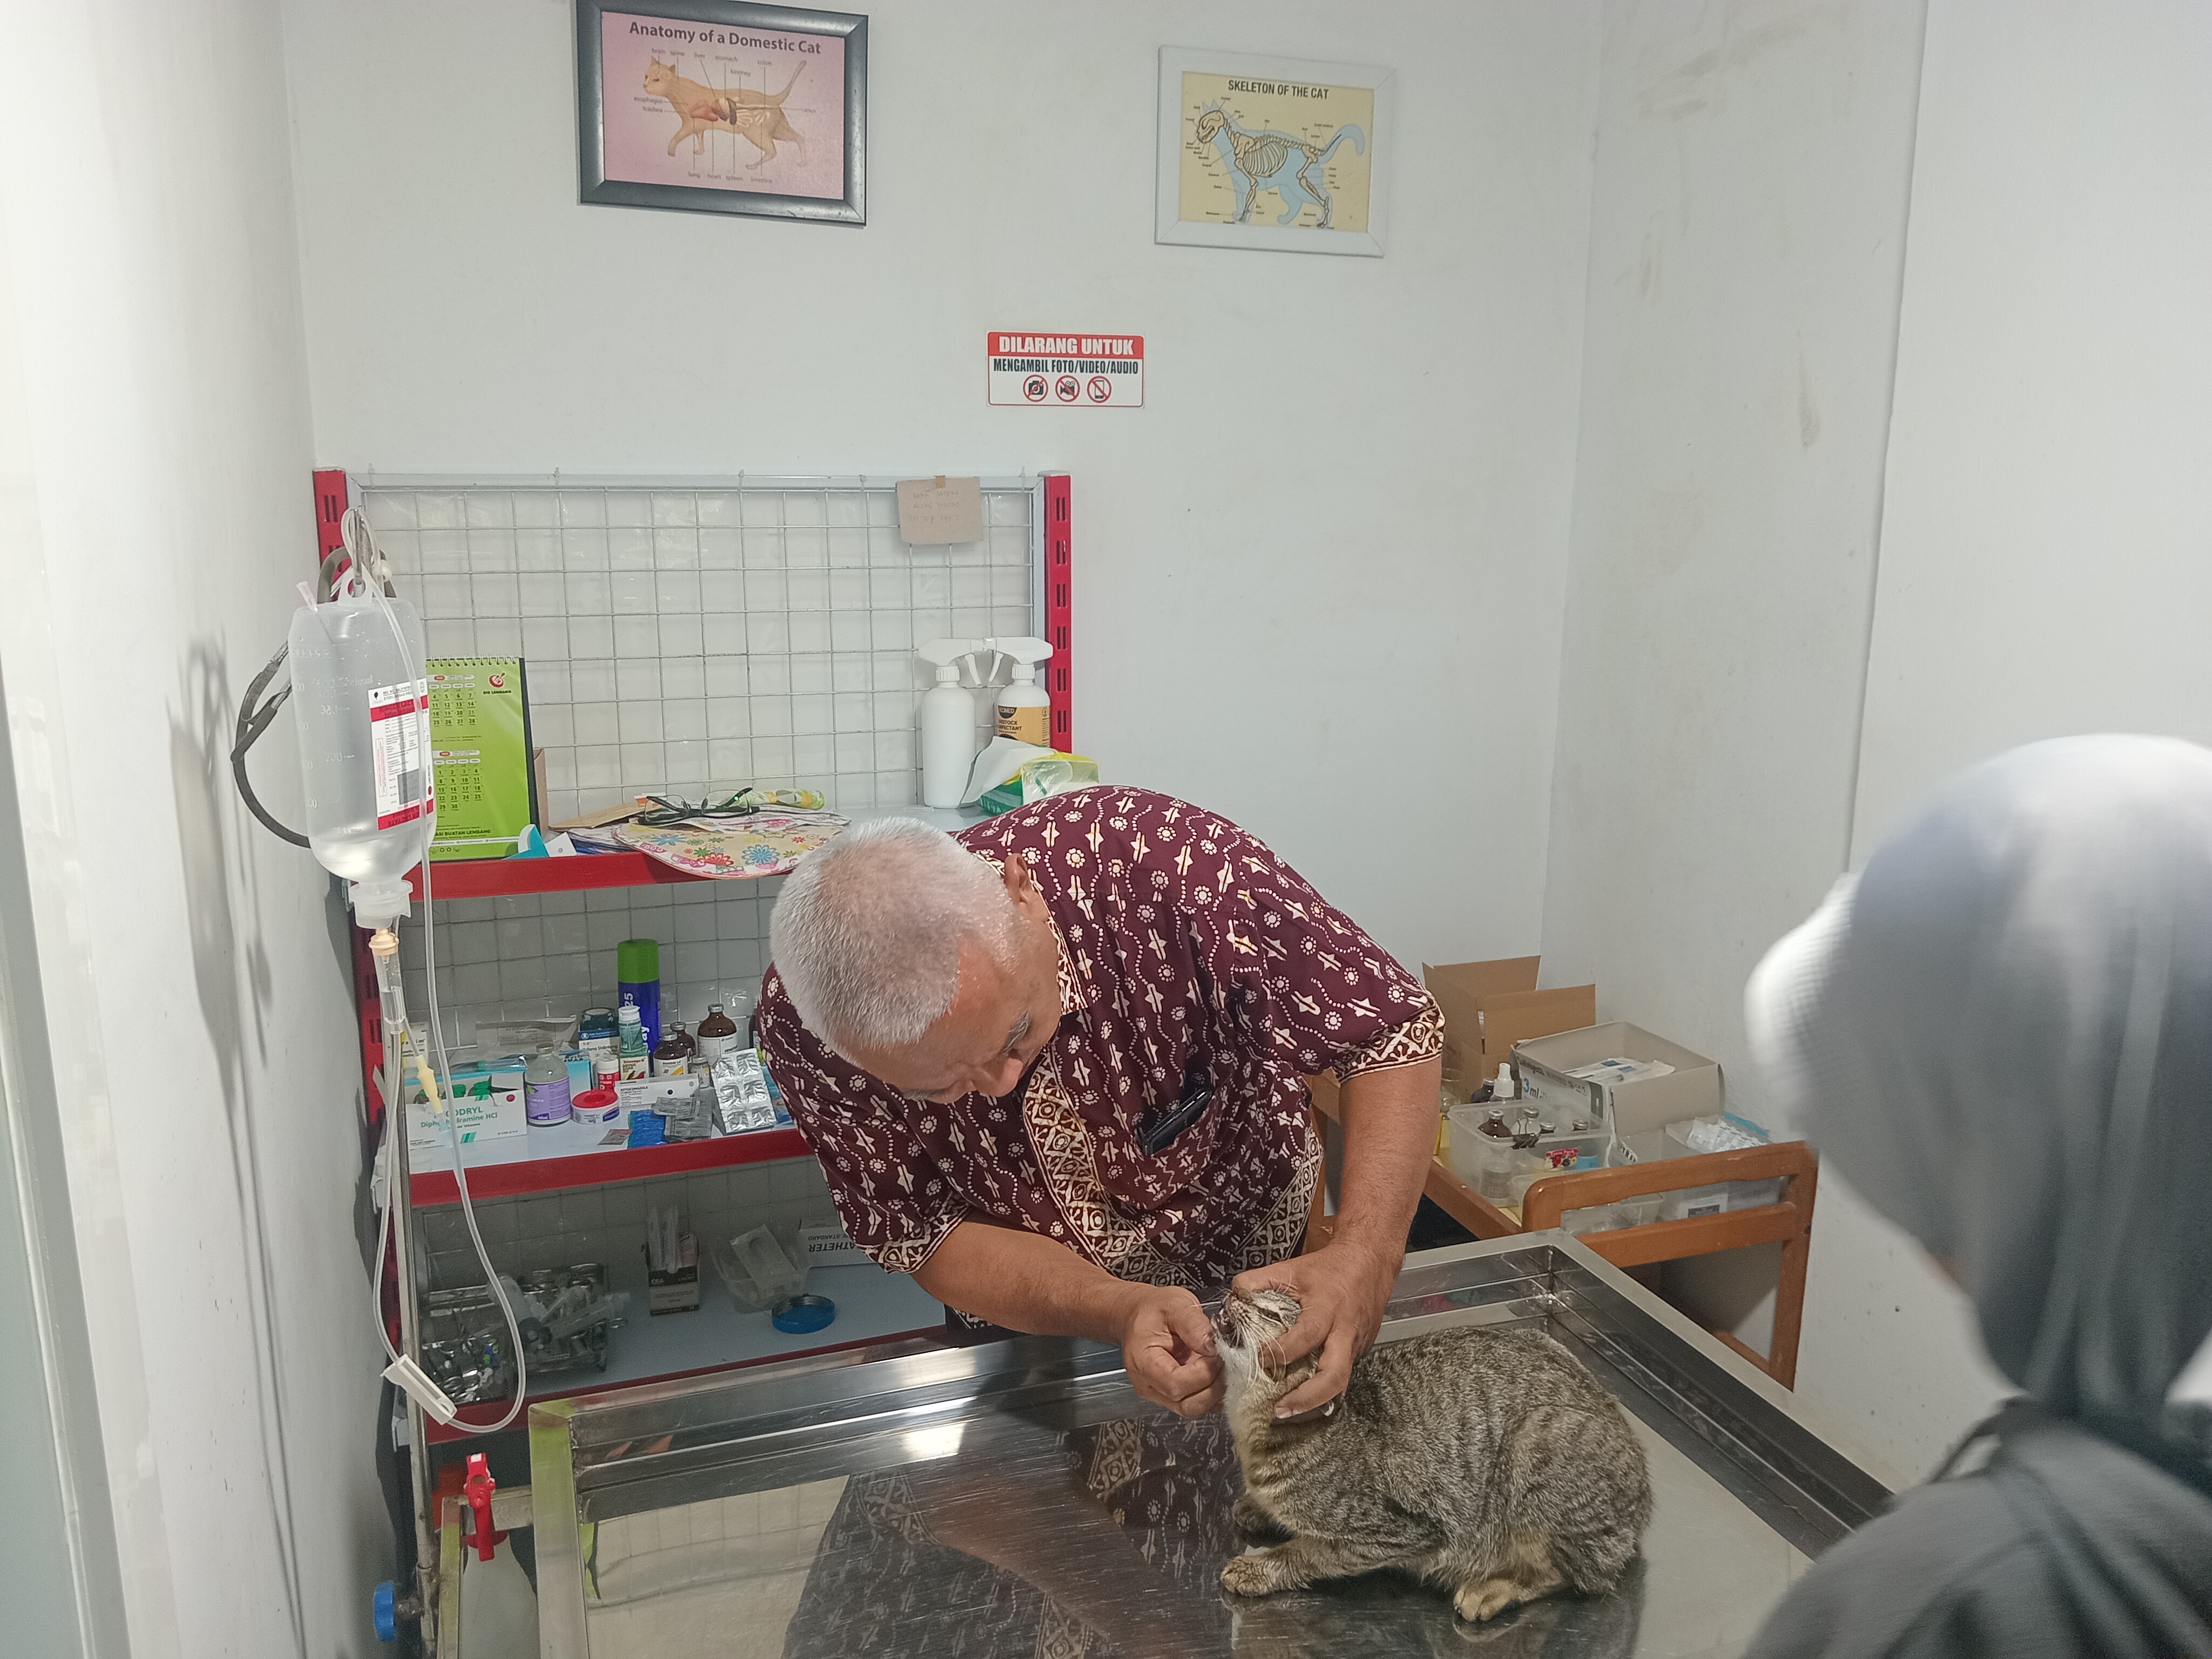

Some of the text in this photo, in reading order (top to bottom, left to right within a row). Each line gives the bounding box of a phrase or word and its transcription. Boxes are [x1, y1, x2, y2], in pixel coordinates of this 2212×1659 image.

[629, 22, 821, 54] Anatomy of a Domestic Cat
[731, 69, 751, 77] kidney
[1228, 79, 1329, 99] SKELETON OF THE CAT
[999, 336, 1134, 355] DILARANG UNTUK
[993, 358, 1138, 374] MENGAMBIL FOTO/VIDEO/AUDIO
[809, 1241, 858, 1252] ATHETER
